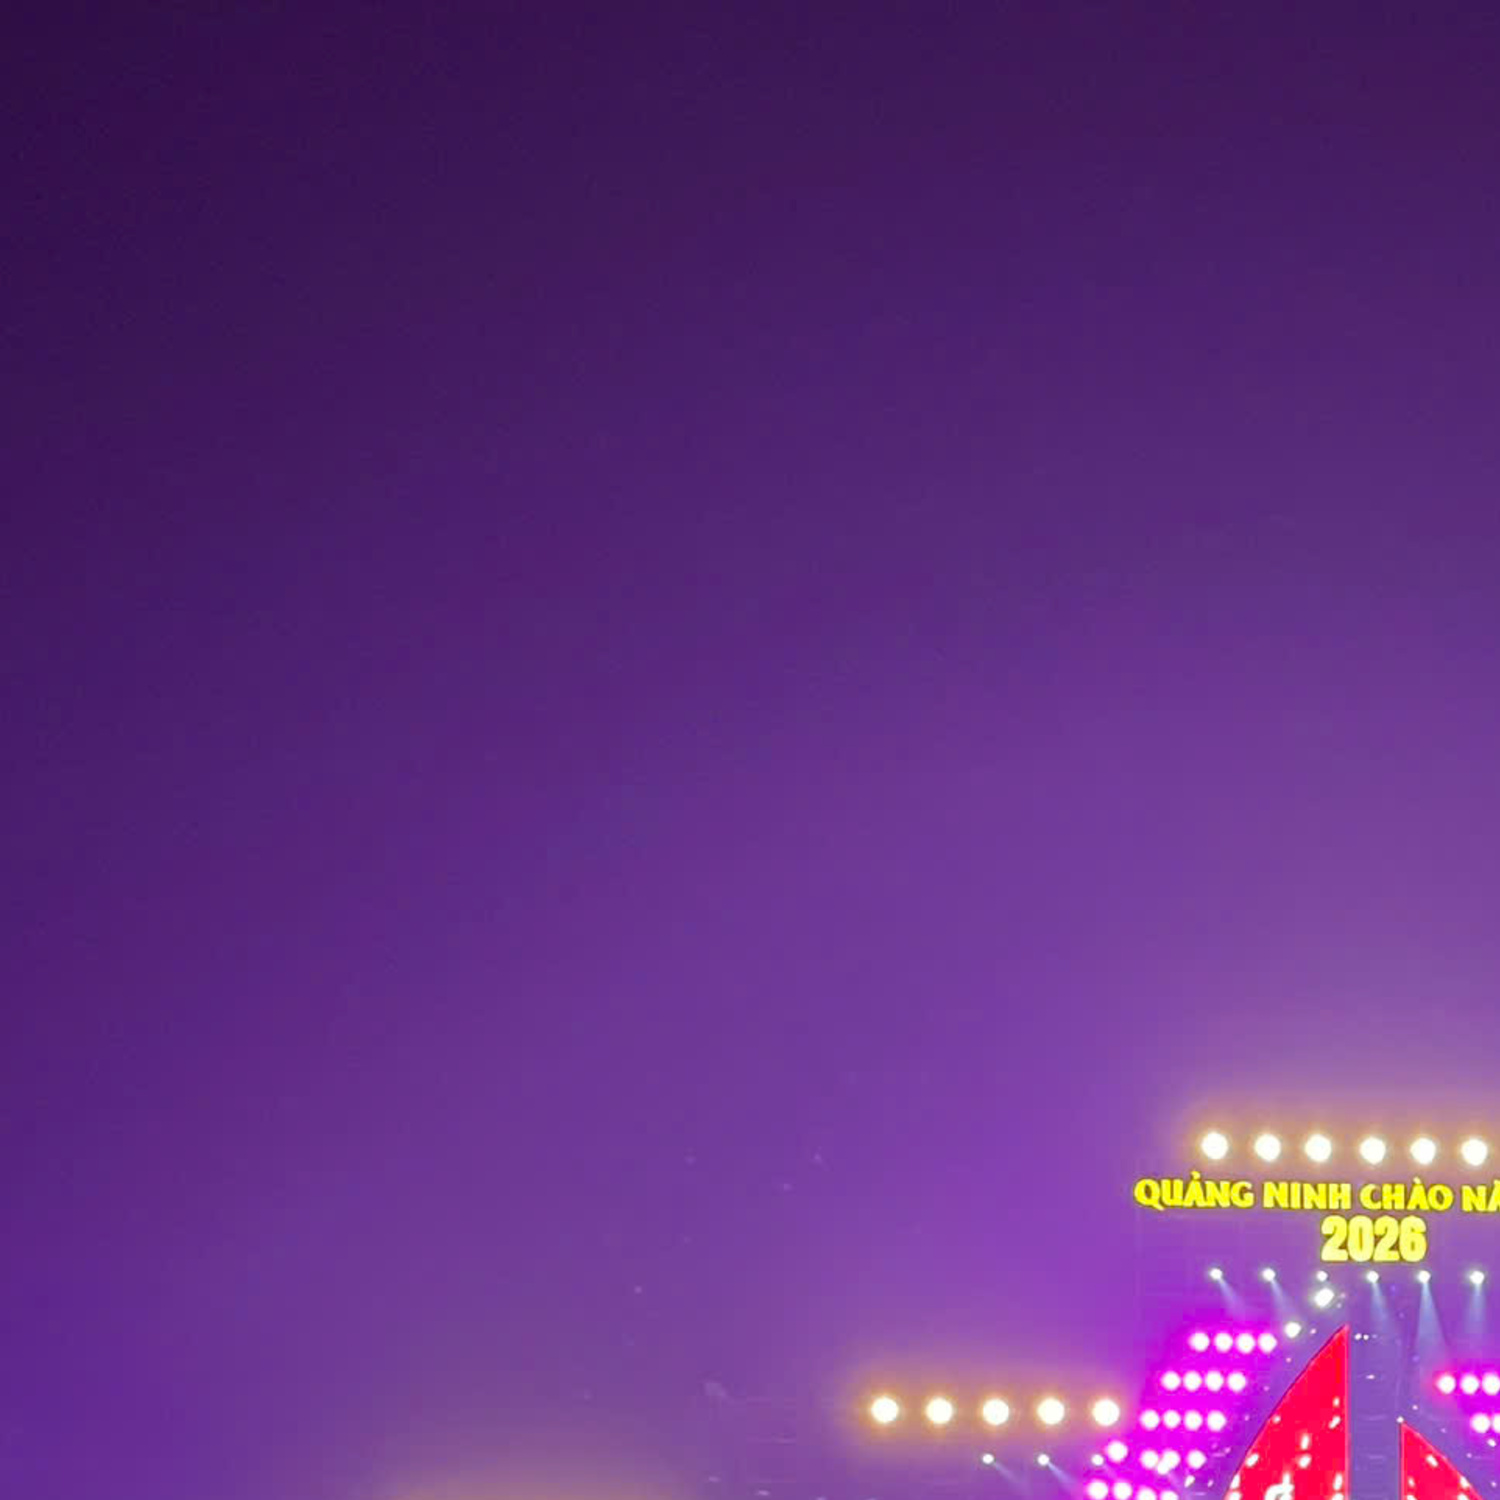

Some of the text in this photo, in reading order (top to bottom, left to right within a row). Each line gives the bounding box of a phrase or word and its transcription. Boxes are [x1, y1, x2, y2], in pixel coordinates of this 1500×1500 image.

[1133, 1170, 1255, 1211] QUẢNG
[1262, 1181, 1352, 1210] NINH
[1359, 1176, 1455, 1211] CHÀO
[1320, 1214, 1428, 1263] 2026
